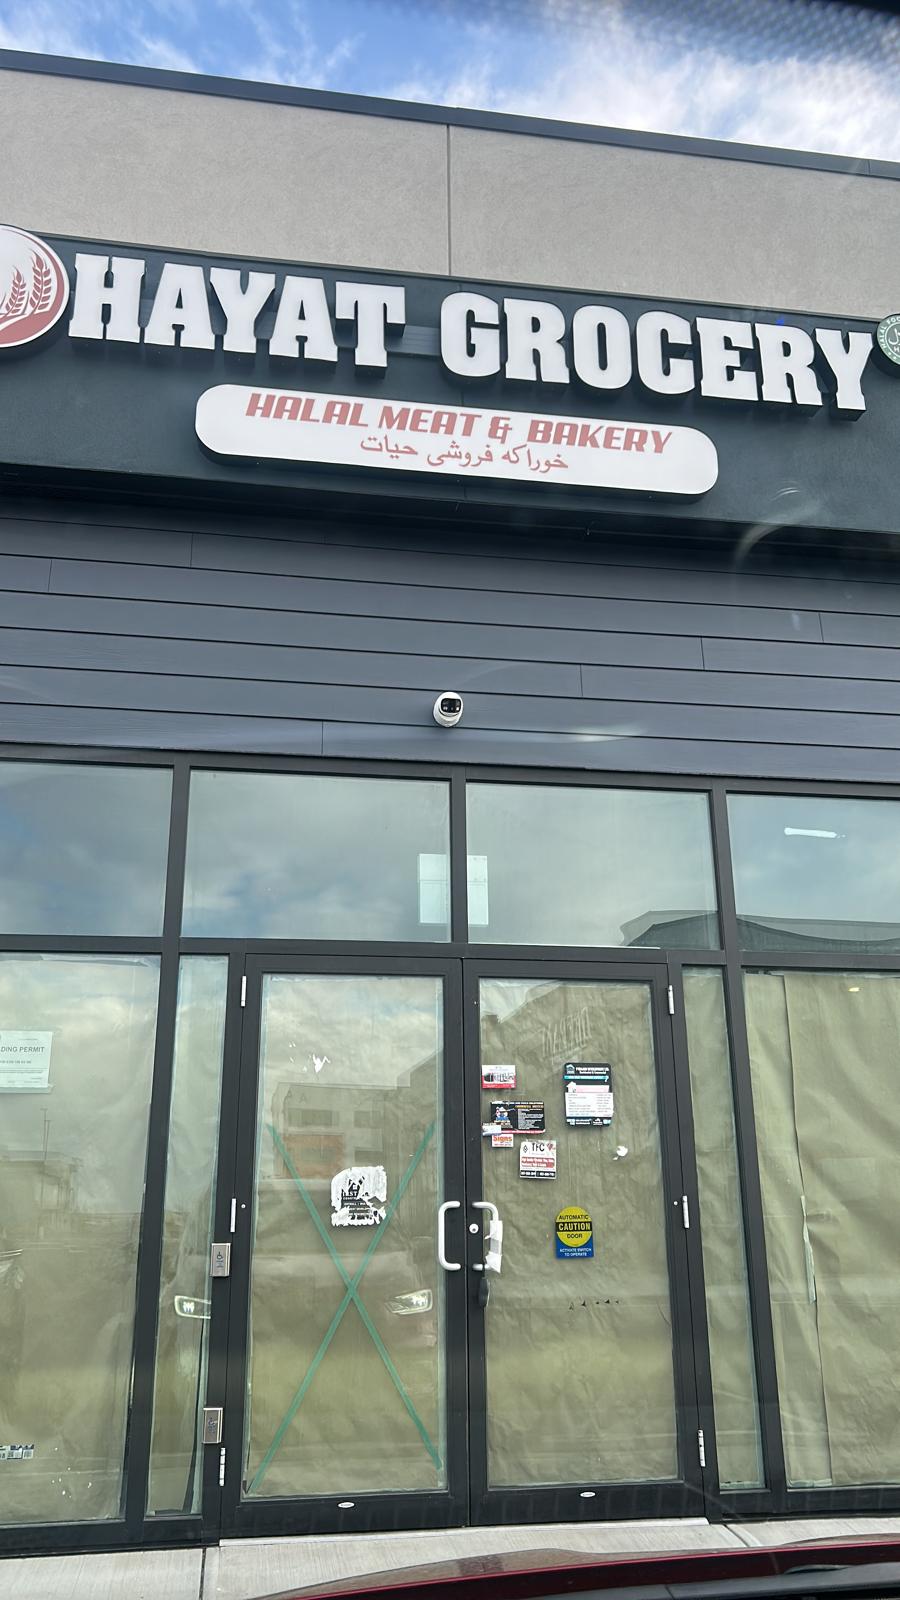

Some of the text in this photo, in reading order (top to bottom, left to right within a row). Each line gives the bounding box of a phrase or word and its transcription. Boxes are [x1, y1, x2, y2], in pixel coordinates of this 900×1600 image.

[69, 253, 873, 411] HAYAT GROCERY
[245, 392, 673, 454] HALAL MEAT & BAKERY
[558, 1222, 590, 1231] CAUTION
